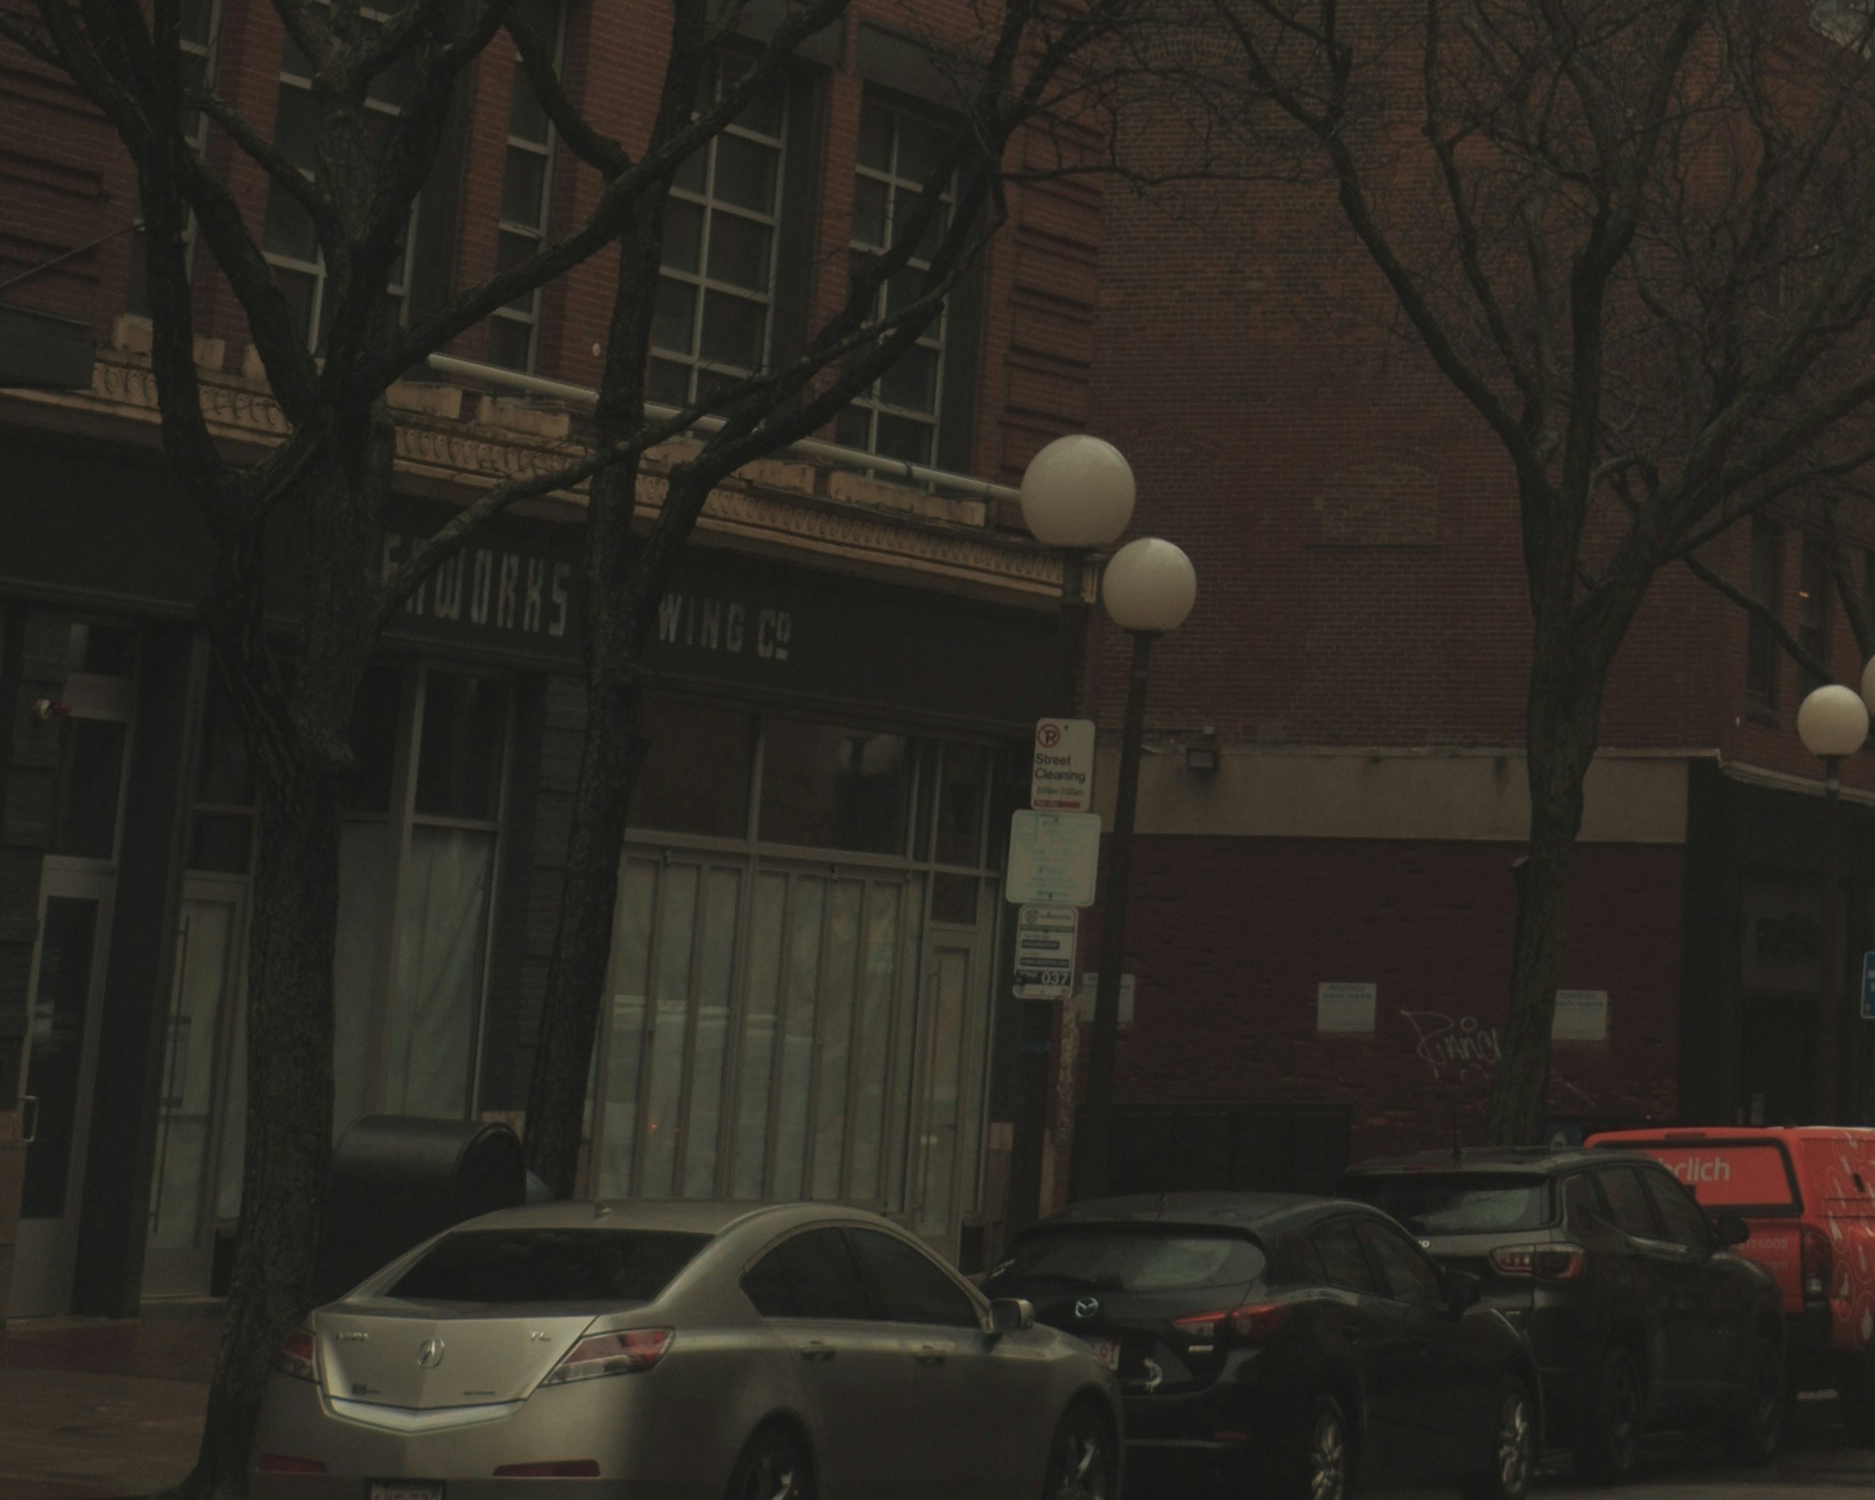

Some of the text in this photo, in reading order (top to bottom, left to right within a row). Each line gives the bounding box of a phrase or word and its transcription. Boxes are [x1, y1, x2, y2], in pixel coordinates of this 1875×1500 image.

[659, 593, 747, 653] WING
[1036, 753, 1072, 766] Street
[1035, 767, 1085, 784] Cleaning
[1041, 971, 1069, 985] 037
[1661, 1156, 1731, 1182] hrlich
